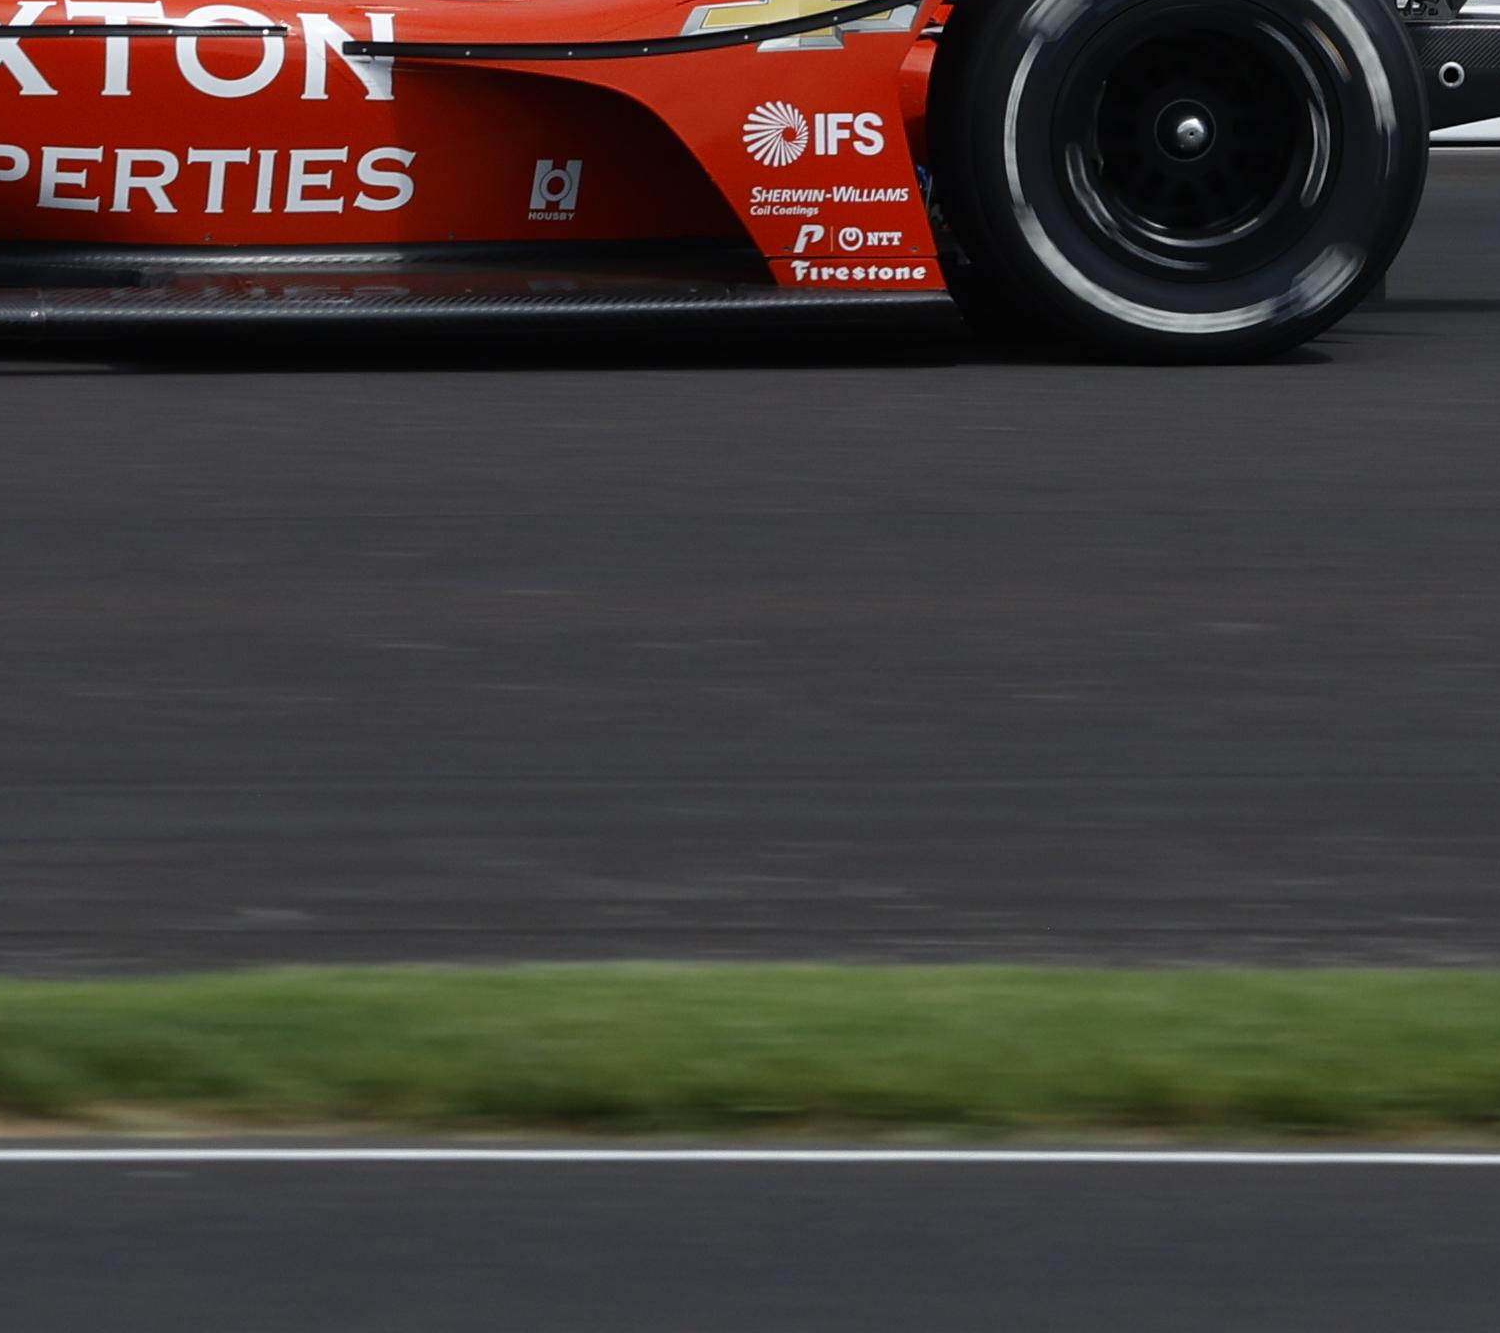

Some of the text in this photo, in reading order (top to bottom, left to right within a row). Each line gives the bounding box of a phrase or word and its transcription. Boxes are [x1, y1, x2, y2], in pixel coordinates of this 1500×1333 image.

[814, 112, 885, 156] IFS
[751, 186, 909, 203] SHERWIN-WILLIAMS
[528, 212, 575, 221] HOUSBY
[750, 205, 819, 217] Coil Coatings
[866, 232, 903, 246] NTT
[791, 260, 926, 282] Firestone
